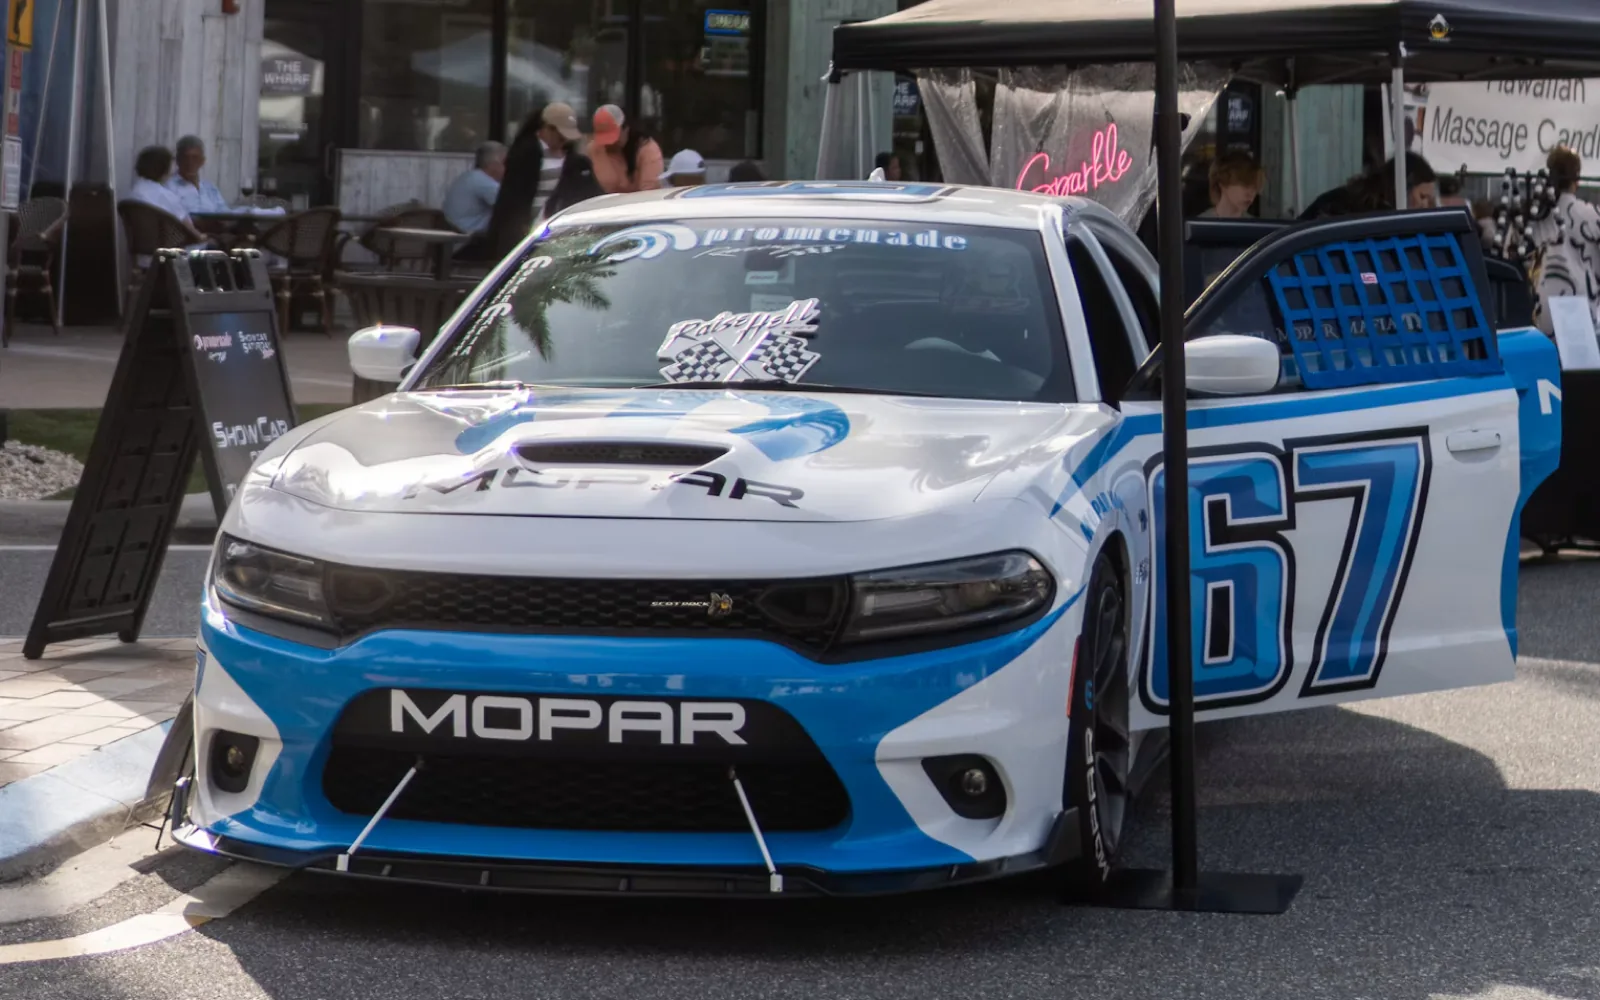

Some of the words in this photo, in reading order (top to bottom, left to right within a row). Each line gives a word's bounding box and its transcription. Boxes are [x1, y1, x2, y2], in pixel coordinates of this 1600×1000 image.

[264, 73, 310, 85] WHARF
[275, 60, 302, 73] THE
[1431, 105, 1529, 160] Massage
[1537, 118, 1600, 160] Candl
[1016, 123, 1133, 197] Sparkle
[703, 226, 969, 251] promenade
[401, 466, 805, 509] MOPAR
[1138, 425, 1432, 716] 67
[391, 688, 749, 746] MOPAR
